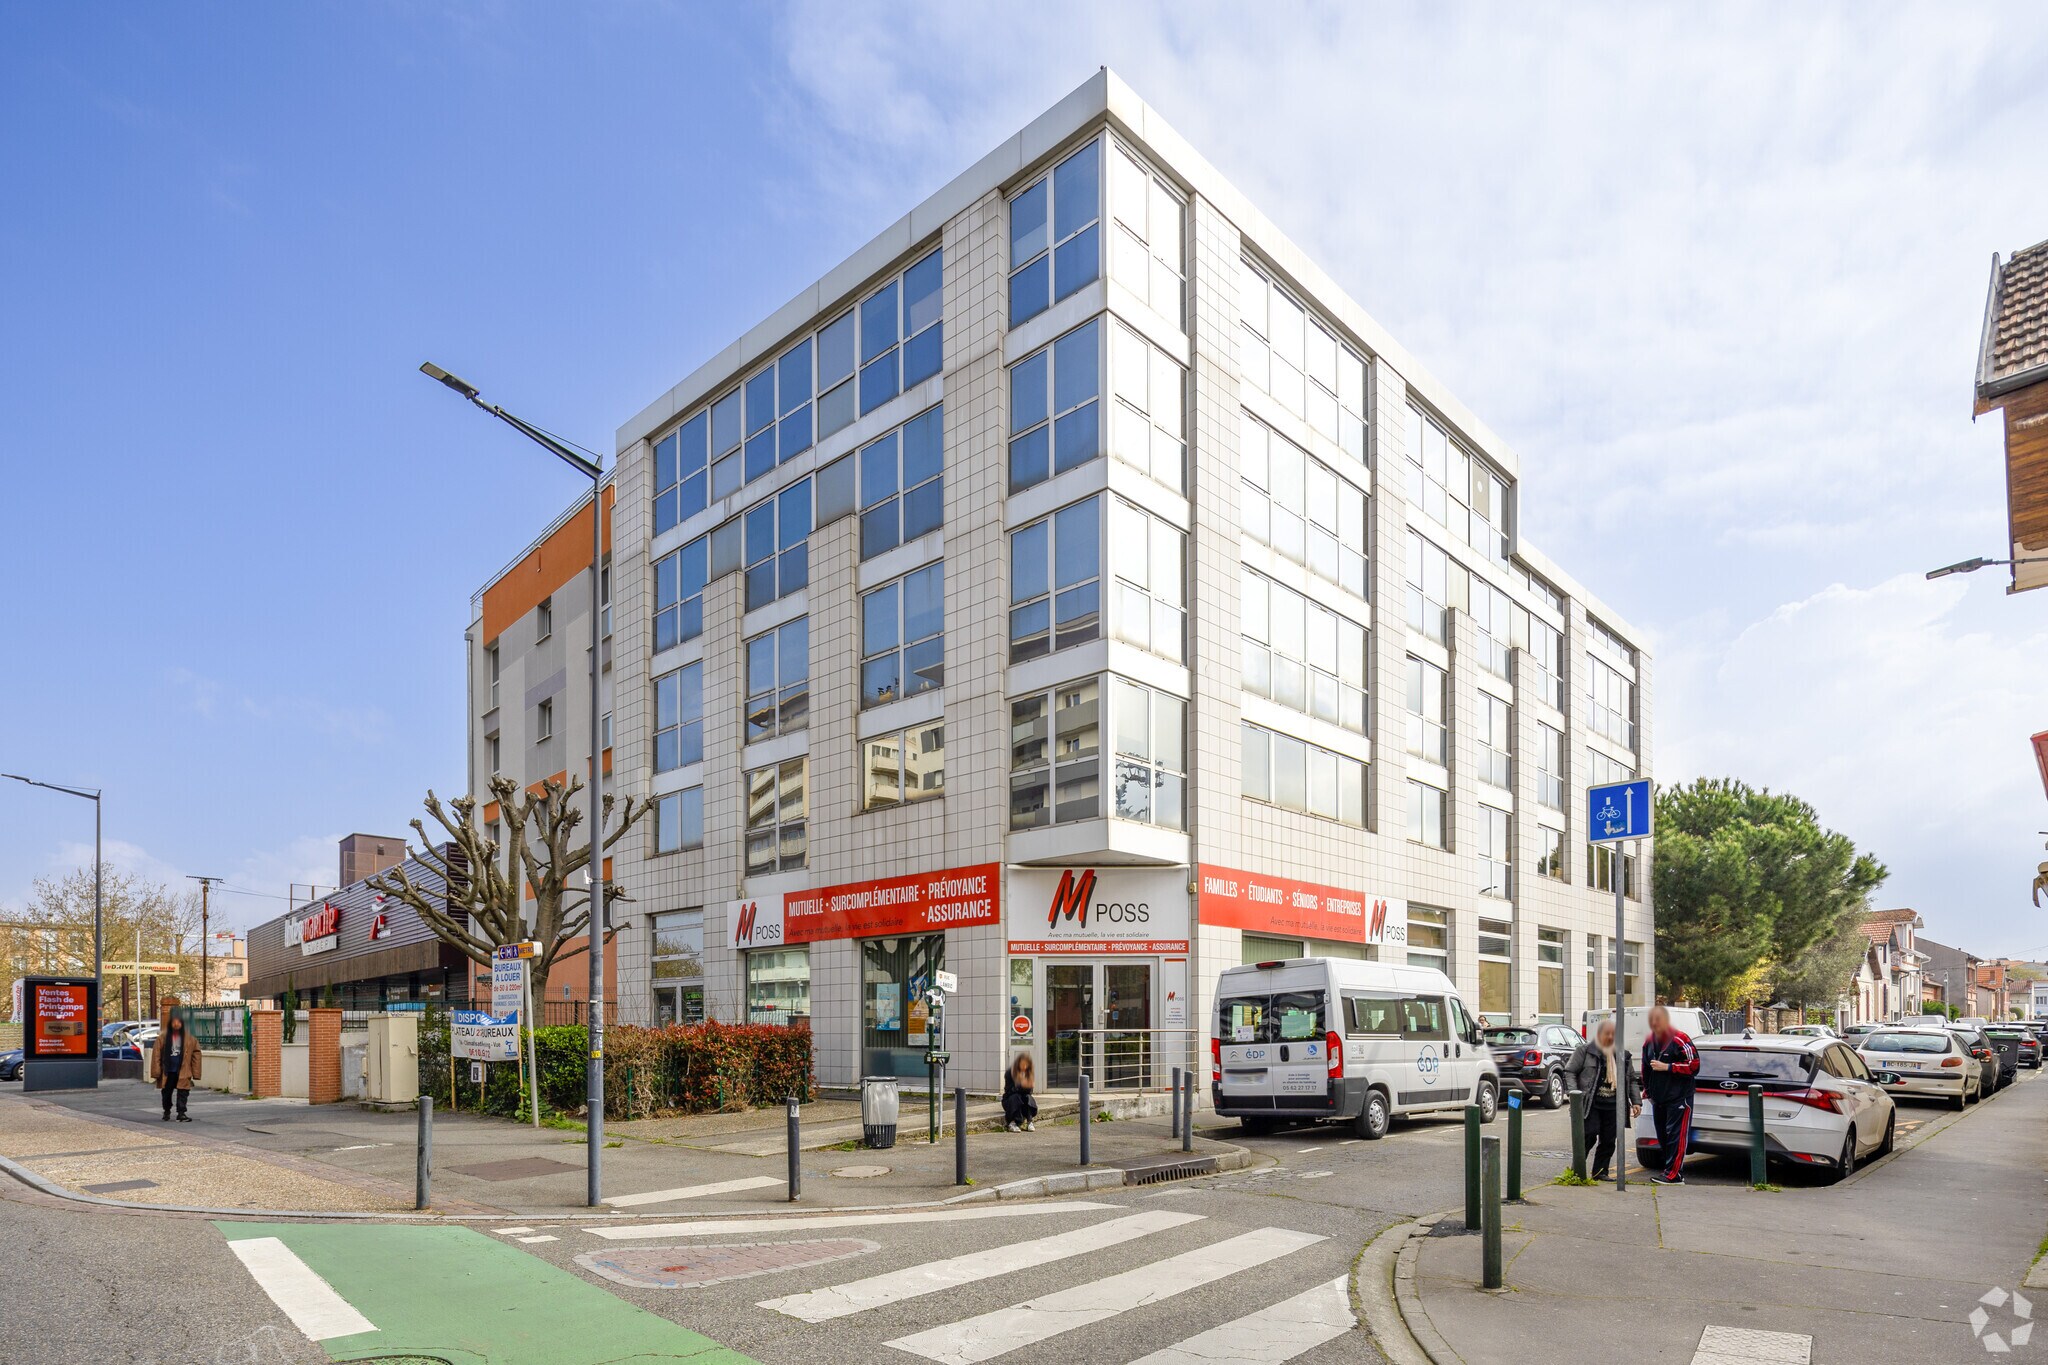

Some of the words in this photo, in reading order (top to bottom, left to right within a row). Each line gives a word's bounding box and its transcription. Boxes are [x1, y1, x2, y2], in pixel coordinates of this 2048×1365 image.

[788, 898, 824, 917] MUTUELLE
[831, 884, 919, 911] SURCOMPLÉMENTAIRE
[928, 876, 987, 900] PRÉVOYANCE
[1204, 876, 1238, 898] FAMILLES
[1248, 881, 1283, 905] ÉTUDIANTS
[1292, 888, 1318, 910] SÉNIORS
[1326, 897, 1362, 916] ENTREPRISES
[927, 899, 991, 923] ASSURANCE
[1096, 903, 1150, 923] POSS
[755, 923, 781, 940] POSS
[1386, 925, 1406, 942] POSS
[1010, 943, 1040, 951] MUTUELLE
[1044, 942, 1107, 951] SURCOMPLÉMENTAIRE
[1112, 942, 1148, 951] PRÉVOYANCE
[1152, 942, 1186, 951] ASSURANCE
[494, 962, 522, 972] BUREAUX
[501, 972, 520, 981] LOUER
[39, 1003, 84, 1012] Printemps
[39, 1010, 74, 1018] Amazon
